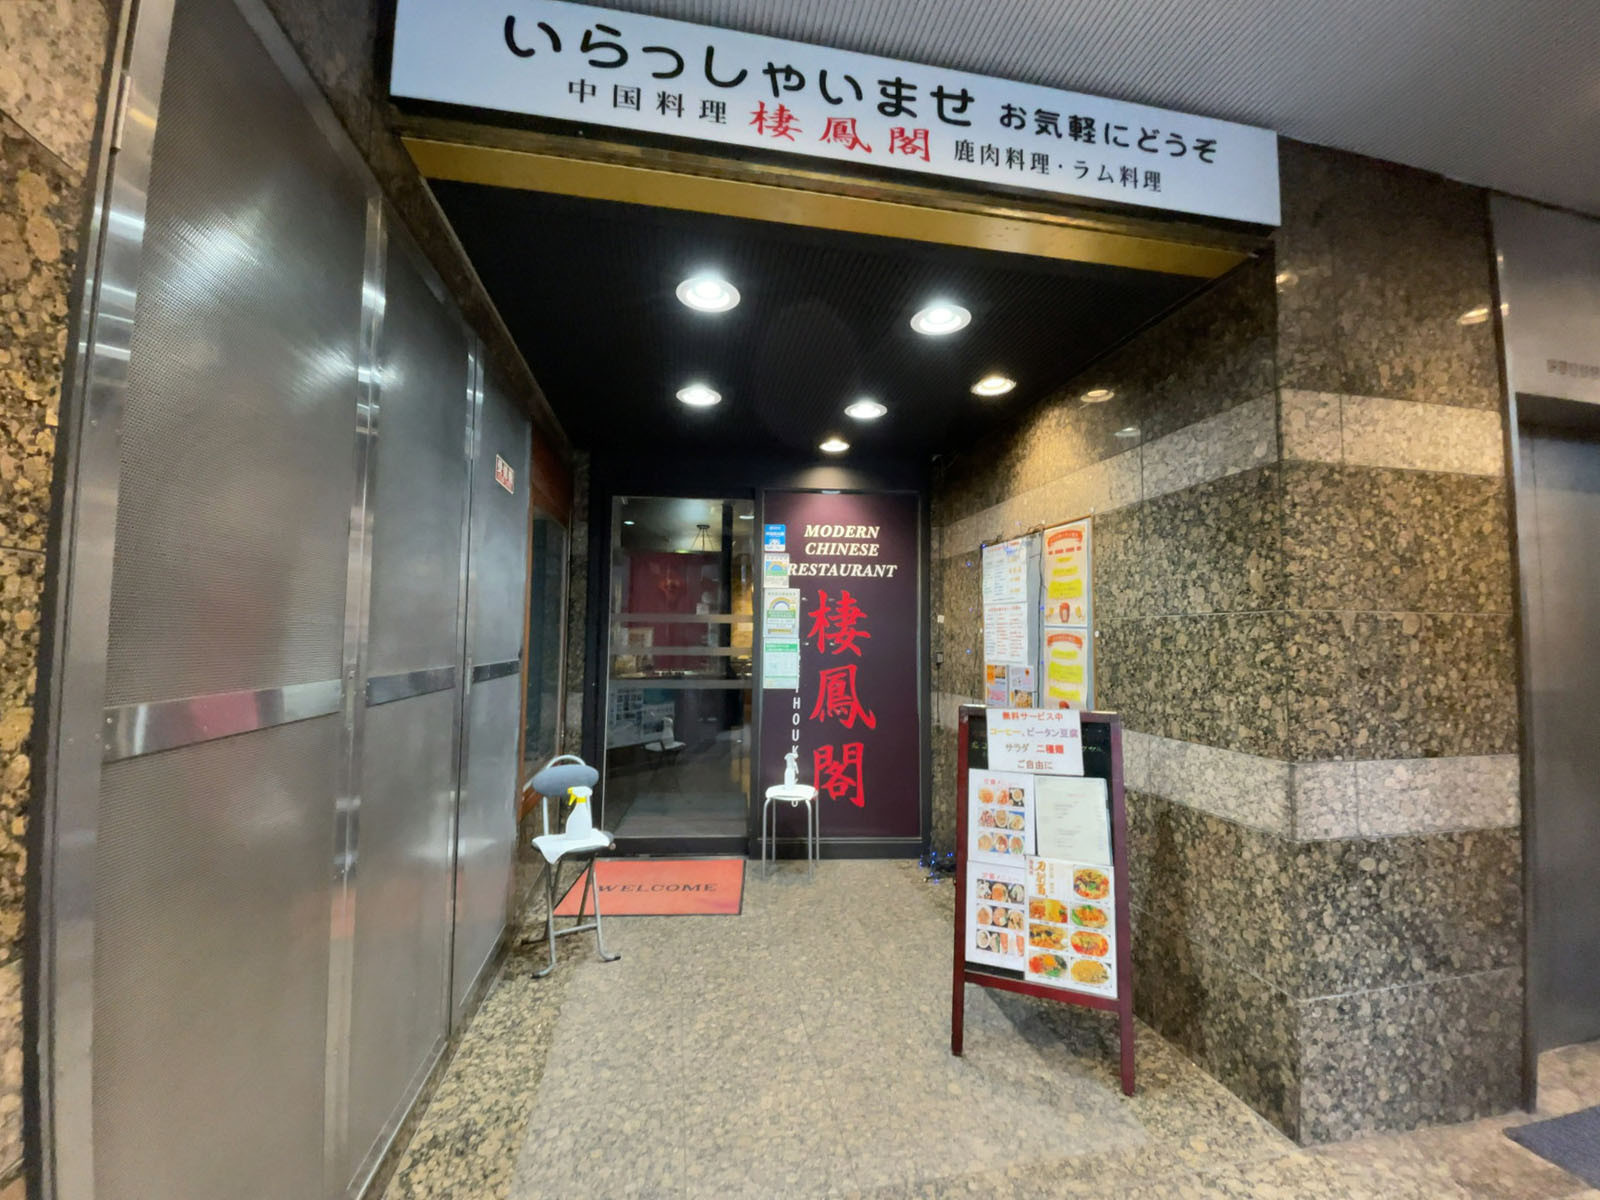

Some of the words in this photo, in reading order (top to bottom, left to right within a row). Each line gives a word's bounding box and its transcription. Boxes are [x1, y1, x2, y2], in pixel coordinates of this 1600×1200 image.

[504, 15, 976, 128] いらっしゃいませ
[999, 102, 1218, 164] お気軽にどうぞ
[568, 78, 728, 126] 中国料理
[749, 101, 932, 163] 棲鳳閣
[953, 138, 1162, 193] 鹿肉料理・ラム料理
[804, 524, 880, 539] MODERN
[804, 542, 880, 557] CHINESE
[787, 562, 898, 578] RESTAURANT
[807, 589, 877, 808] 棲鳳閣
[598, 883, 718, 892] WELCOME
